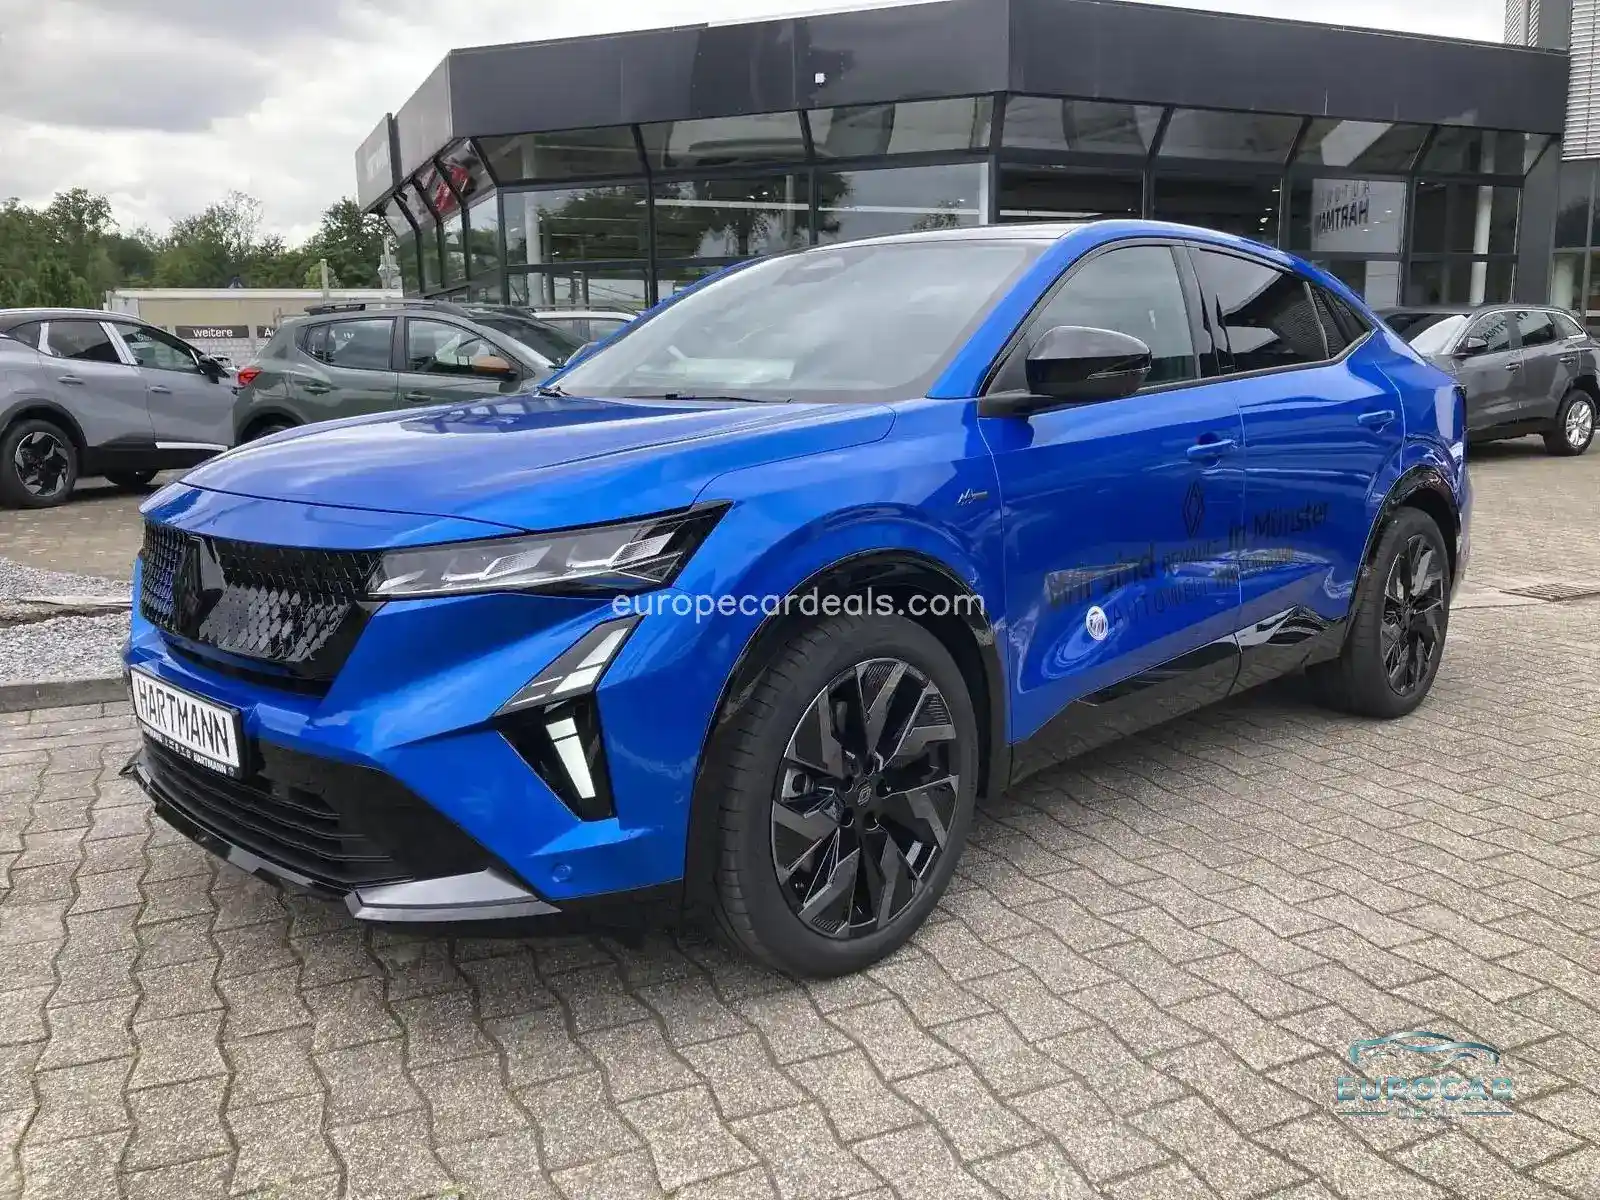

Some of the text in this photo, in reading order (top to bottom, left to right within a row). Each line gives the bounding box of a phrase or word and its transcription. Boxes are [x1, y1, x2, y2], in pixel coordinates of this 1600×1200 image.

[192, 327, 233, 338] weitere
[1254, 500, 1328, 537] Münster
[137, 679, 230, 758] HARTMANN
